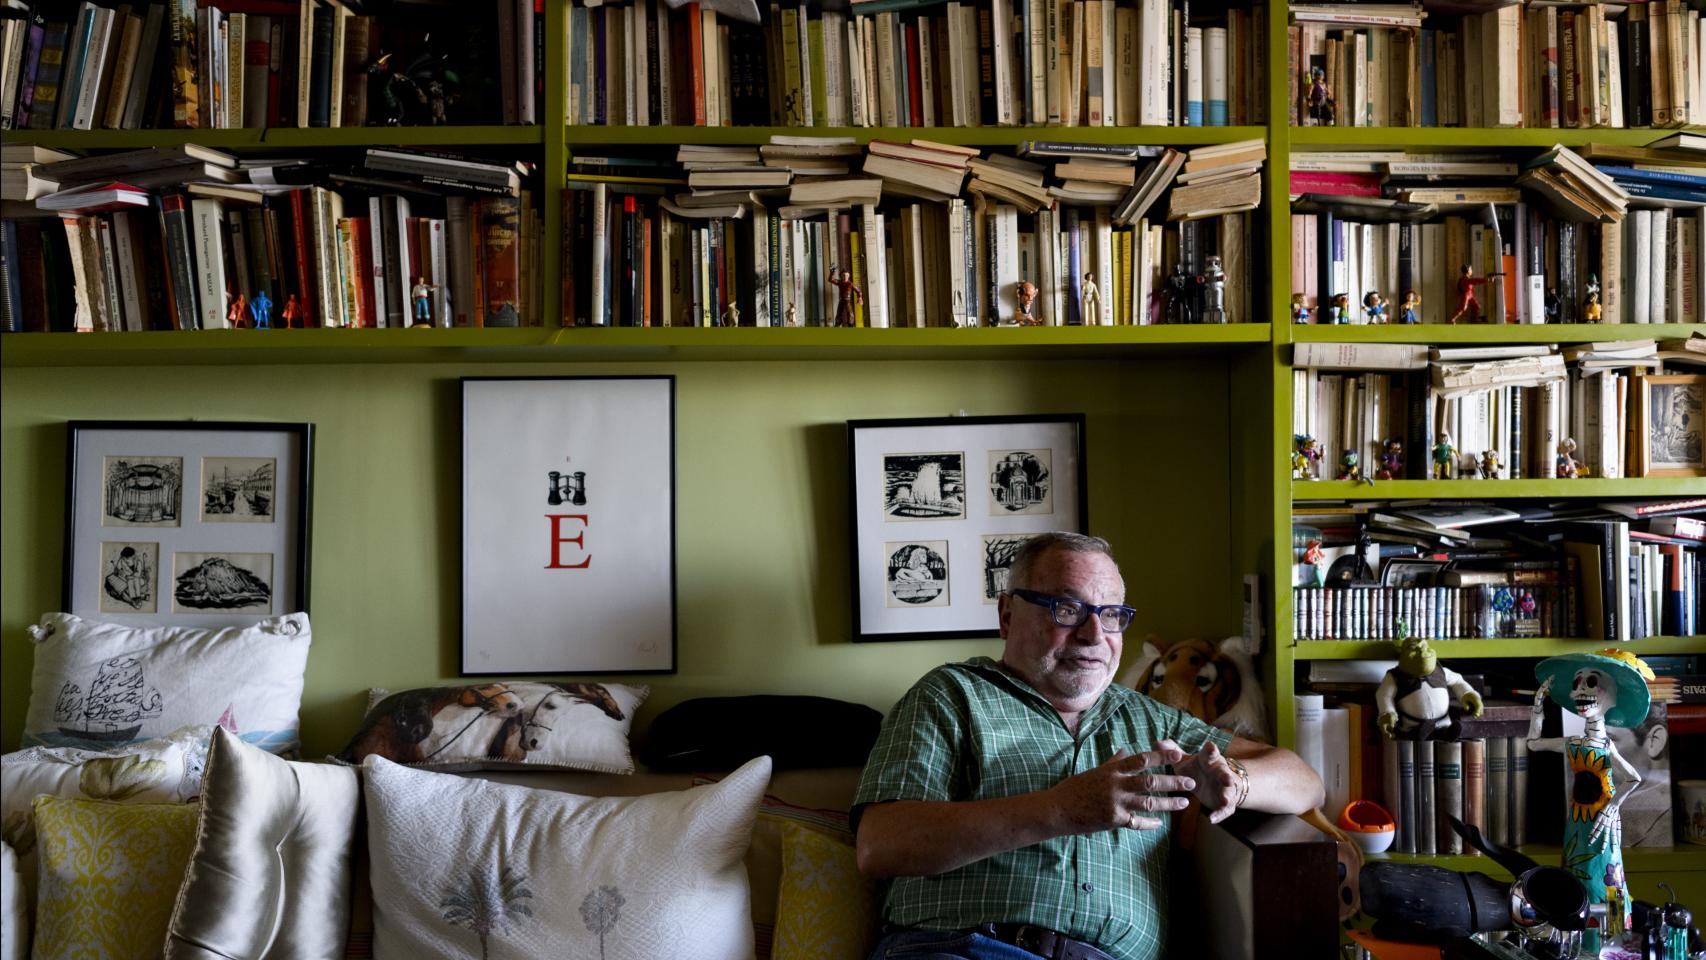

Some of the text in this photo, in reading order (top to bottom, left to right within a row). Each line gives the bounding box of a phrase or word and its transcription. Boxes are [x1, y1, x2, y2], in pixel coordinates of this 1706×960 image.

[1565, 27, 1575, 102] BARRA SINIESTRA
[201, 213, 210, 237] Bernhard
[673, 259, 681, 295] Quevedo
[1478, 398, 1486, 423] LEZAMA
[544, 514, 592, 569] E
